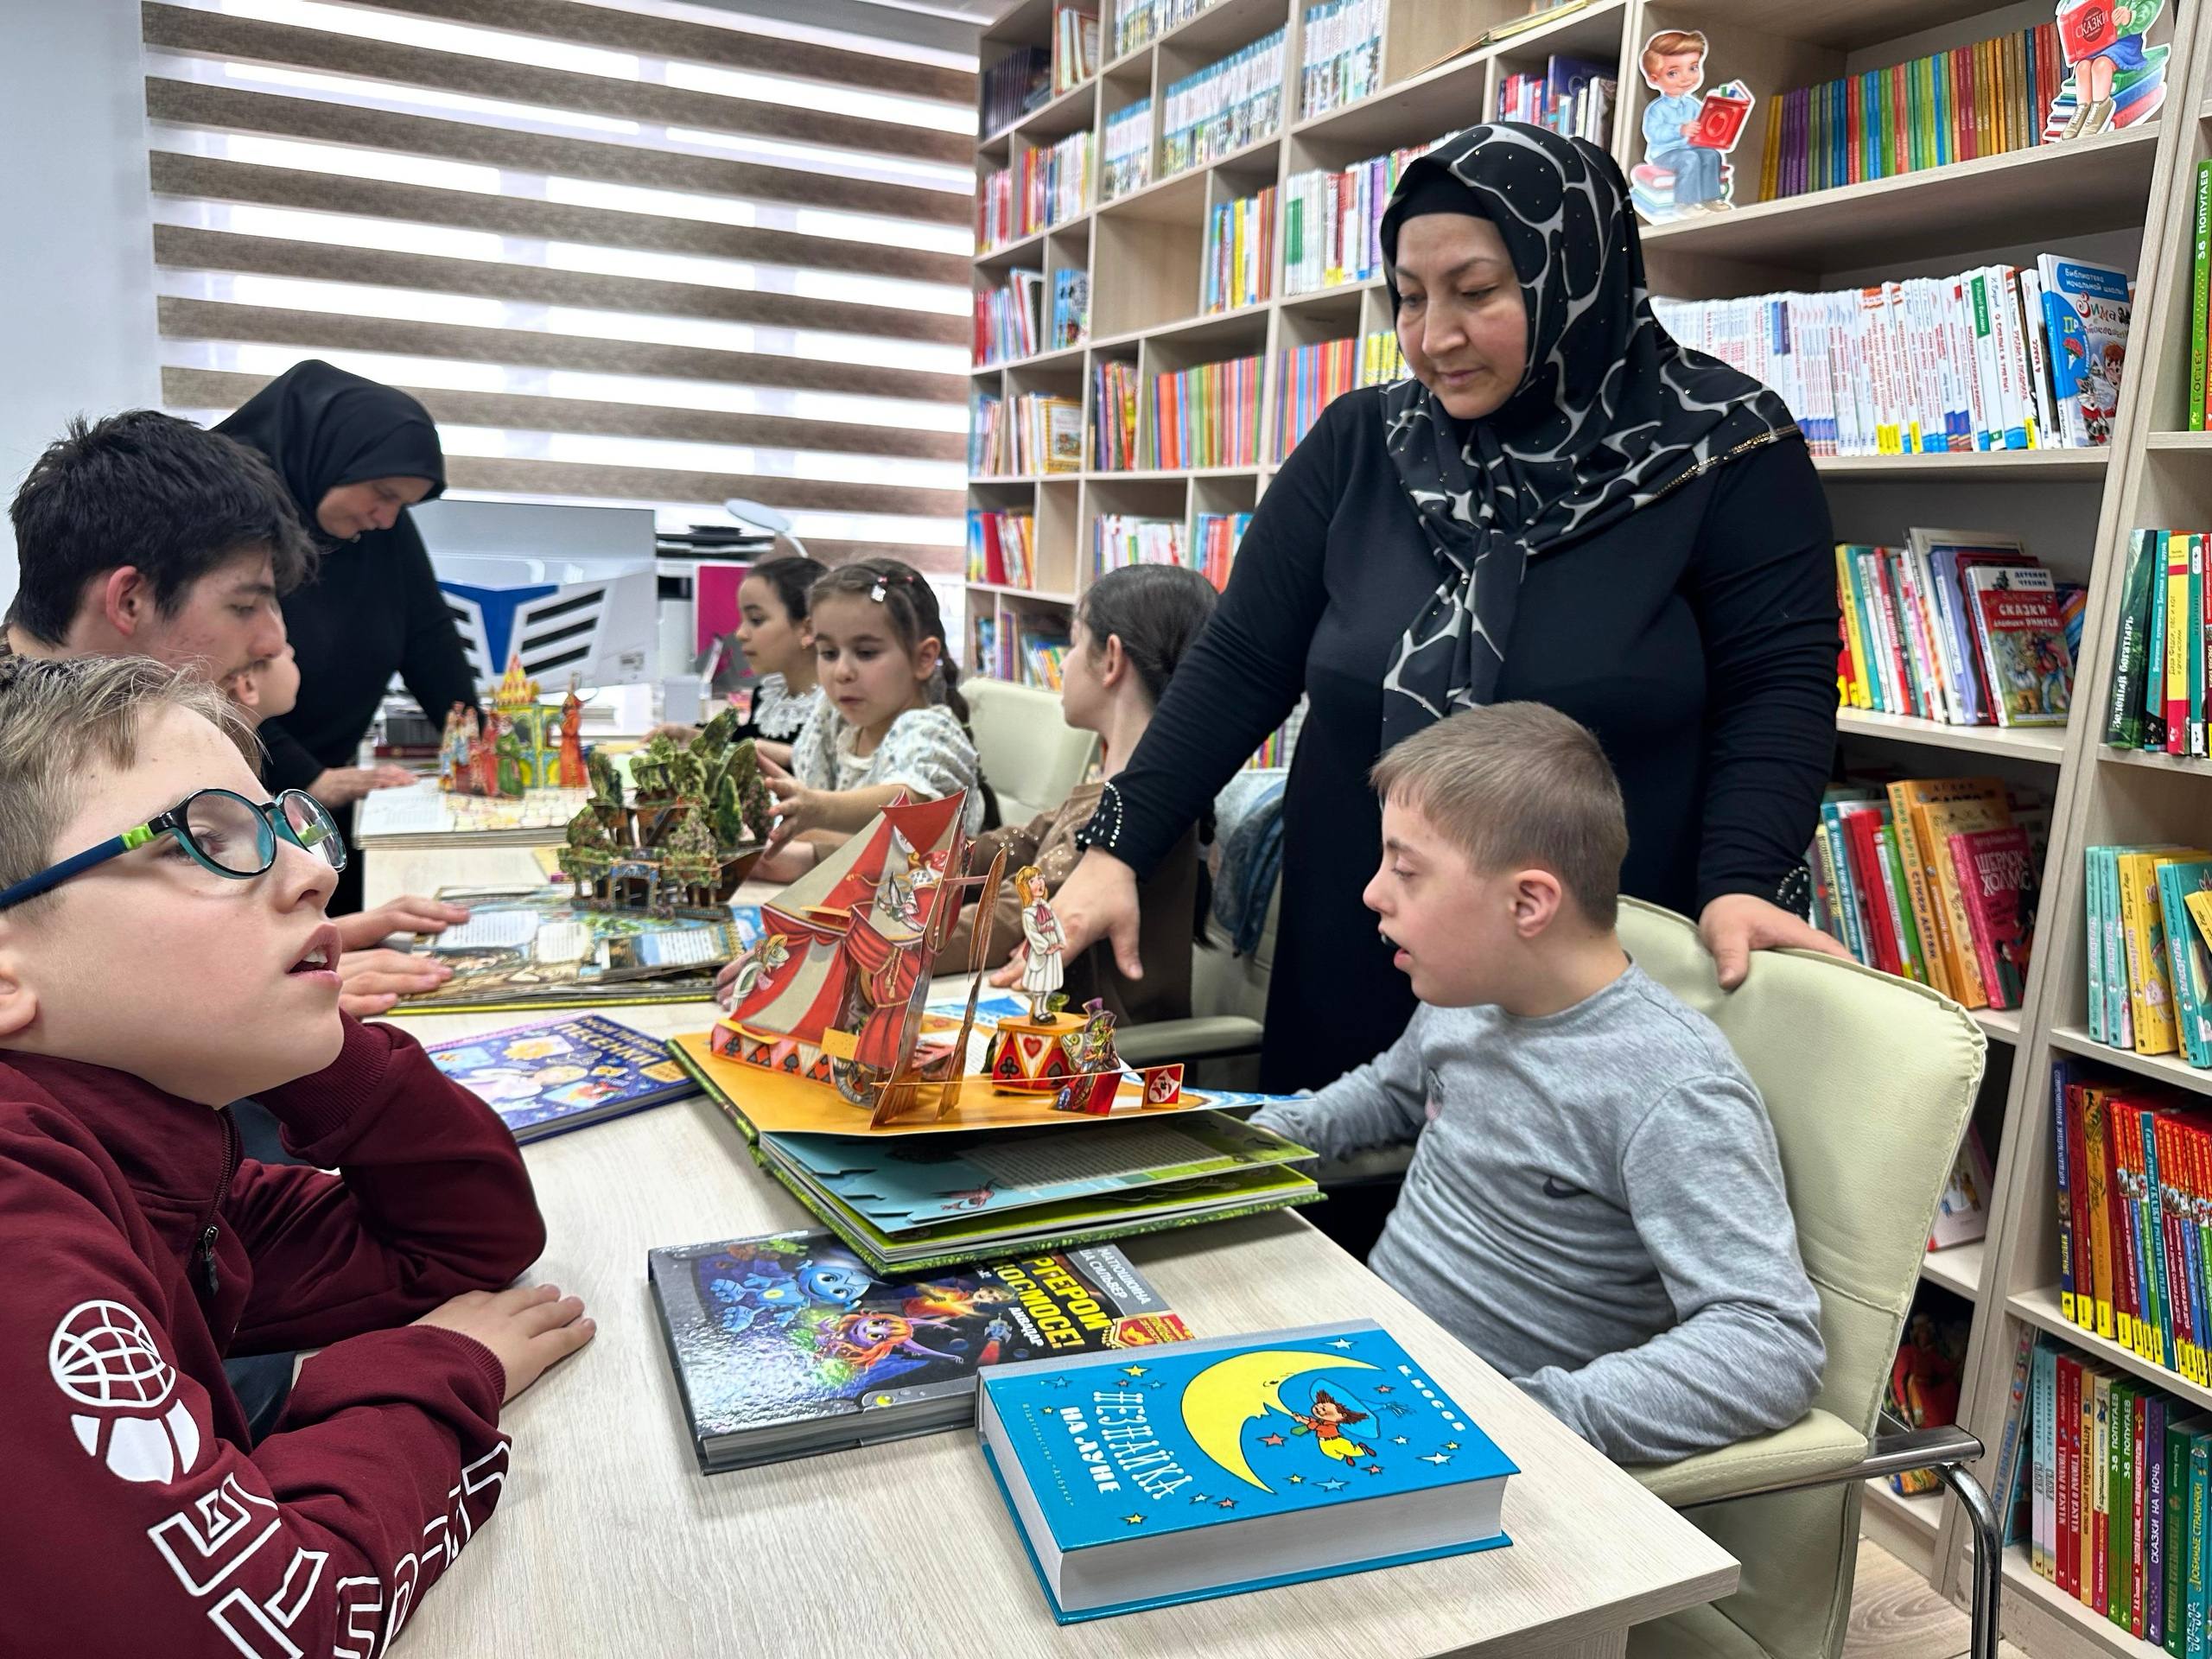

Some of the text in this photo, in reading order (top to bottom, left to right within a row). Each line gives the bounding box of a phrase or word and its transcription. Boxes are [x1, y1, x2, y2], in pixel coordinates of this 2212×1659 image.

[2075, 10, 2109, 38] СКАЗКИ
[2198, 169, 2209, 260] 38 ПОПУГАЕВ
[2075, 290, 2117, 322] Зима
[2193, 350, 2202, 391] ОСТЕР
[1999, 604, 2046, 616] СКАЗКИ
[1974, 849, 2029, 874] ШЕРЛОК
[1980, 869, 2031, 898] ХОЛМС
[1088, 1259, 1128, 1300] СИЛЬВЕР
[1096, 1248, 1152, 1306] МАТЮШКИНА
[1022, 1402, 1052, 1460] Издательство
[1410, 1378, 1466, 1432] НОСОВ
[1059, 1406, 1122, 1495] НА ЛУНЕ
[1093, 1390, 1193, 1501] НЕЗНАЙКА
[2111, 1392, 2120, 1473] 38 ПОПУГАЕВ
[2123, 1399, 2132, 1478] 38 ПОПУГАЕВ
[2151, 1463, 2161, 1564] СКАЗКИ НА НОЧЬ
[2191, 1482, 2203, 1535] СТРАНИЧКИ
